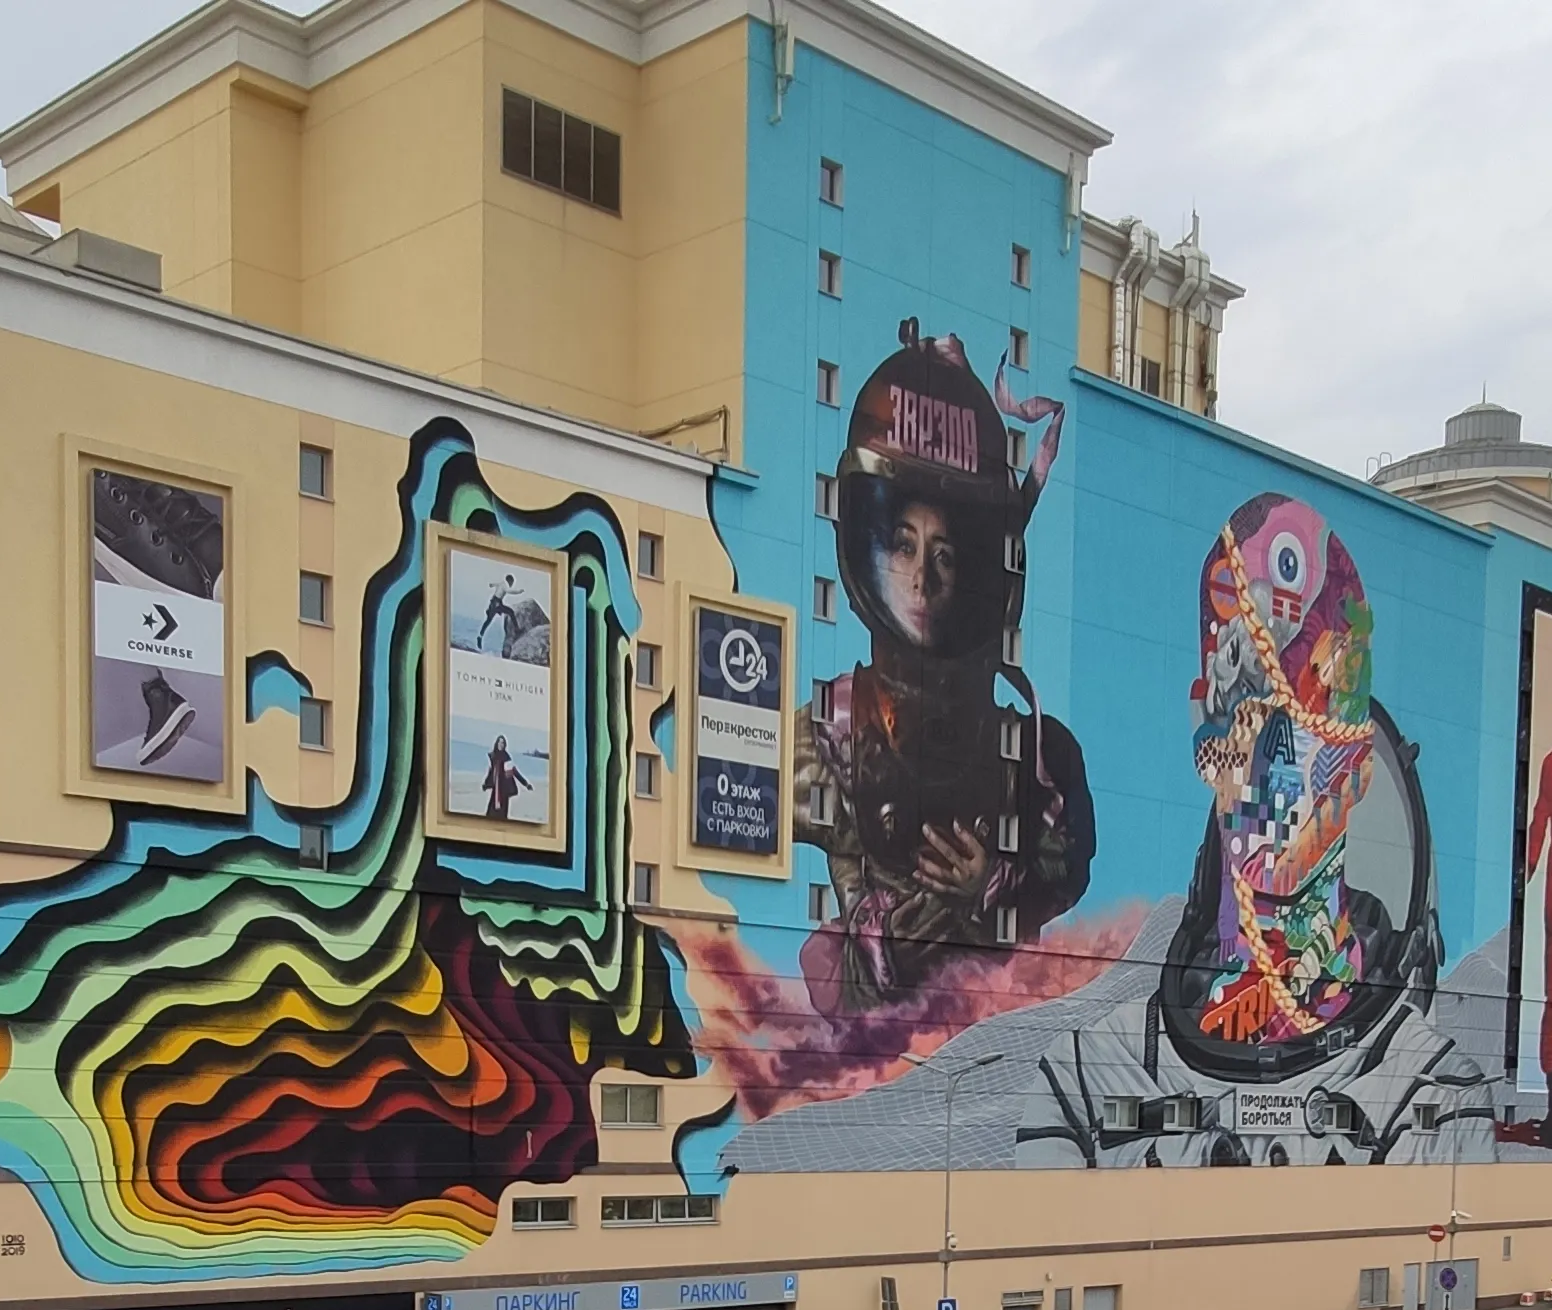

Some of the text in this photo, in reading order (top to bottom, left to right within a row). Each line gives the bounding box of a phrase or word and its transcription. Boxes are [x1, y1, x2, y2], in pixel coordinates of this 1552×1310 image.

[127, 640, 194, 660] CONVERSE
[746, 654, 768, 681] 24
[456, 671, 544, 695] TOMMY HILFIGER
[701, 714, 777, 743] Перекресток
[731, 783, 761, 801] ЭТАЖ
[712, 800, 765, 825] ЕСТЬ ВХОД
[716, 819, 770, 840] ПАРКОВКИ
[1240, 1094, 1305, 1110] ПРОДОЛЖАТЬ
[1241, 1111, 1292, 1126] БОРОТЬСЯ
[1, 1245, 26, 1257] 2019
[623, 1287, 637, 1302] 24
[680, 1281, 747, 1304] PARKING
